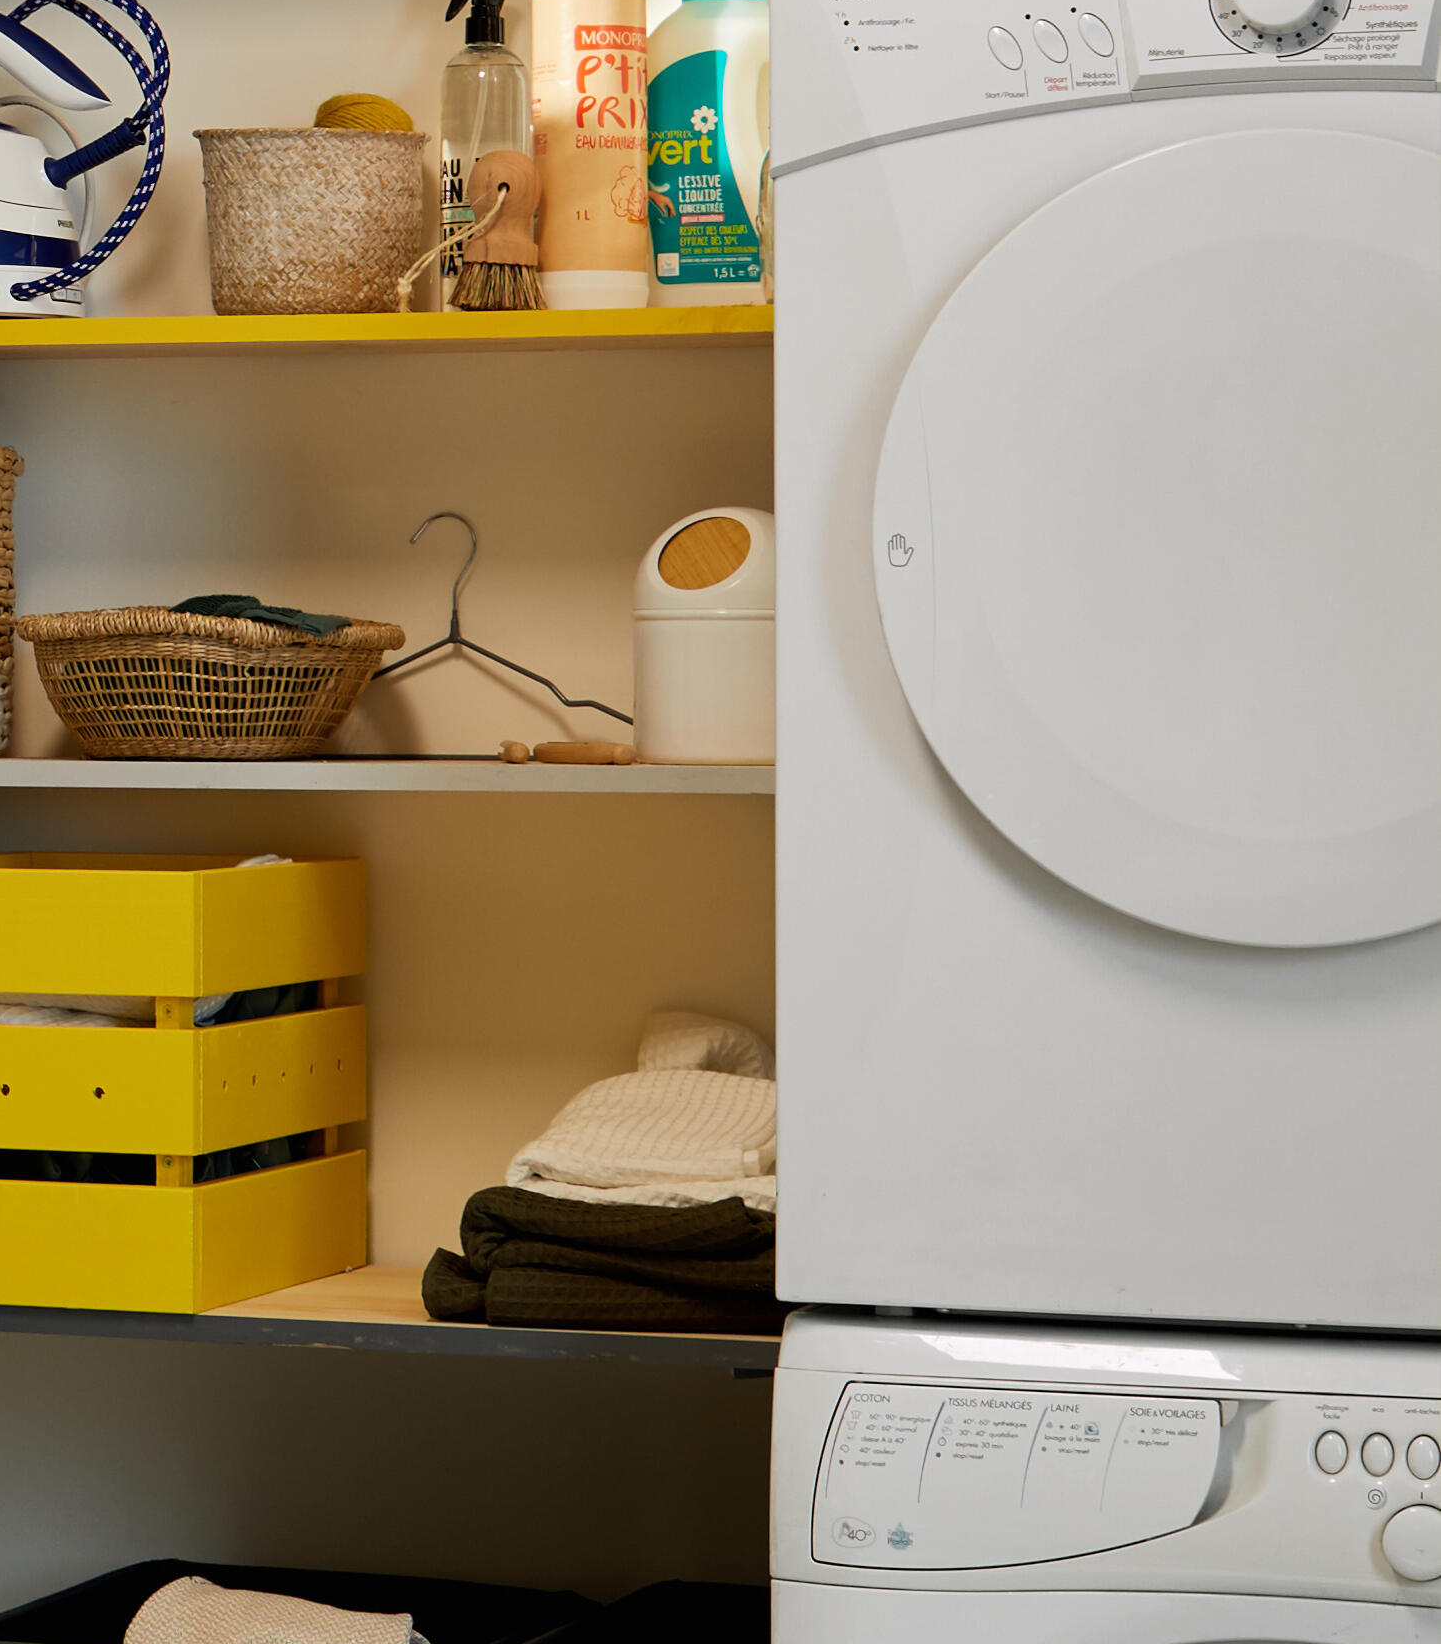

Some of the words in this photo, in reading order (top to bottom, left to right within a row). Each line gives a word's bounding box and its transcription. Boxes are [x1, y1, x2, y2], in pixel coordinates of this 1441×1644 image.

[575, 134, 597, 149] EAU
[678, 174, 722, 189] LESSIVE
[678, 188, 723, 204] LIQUIDE
[853, 1393, 891, 1403] COTON
[948, 1397, 978, 1407] TISSUS
[1050, 1403, 1081, 1414] LAINE
[1129, 1407, 1152, 1417] SOIE
[1158, 1408, 1206, 1420] VOILAGES
